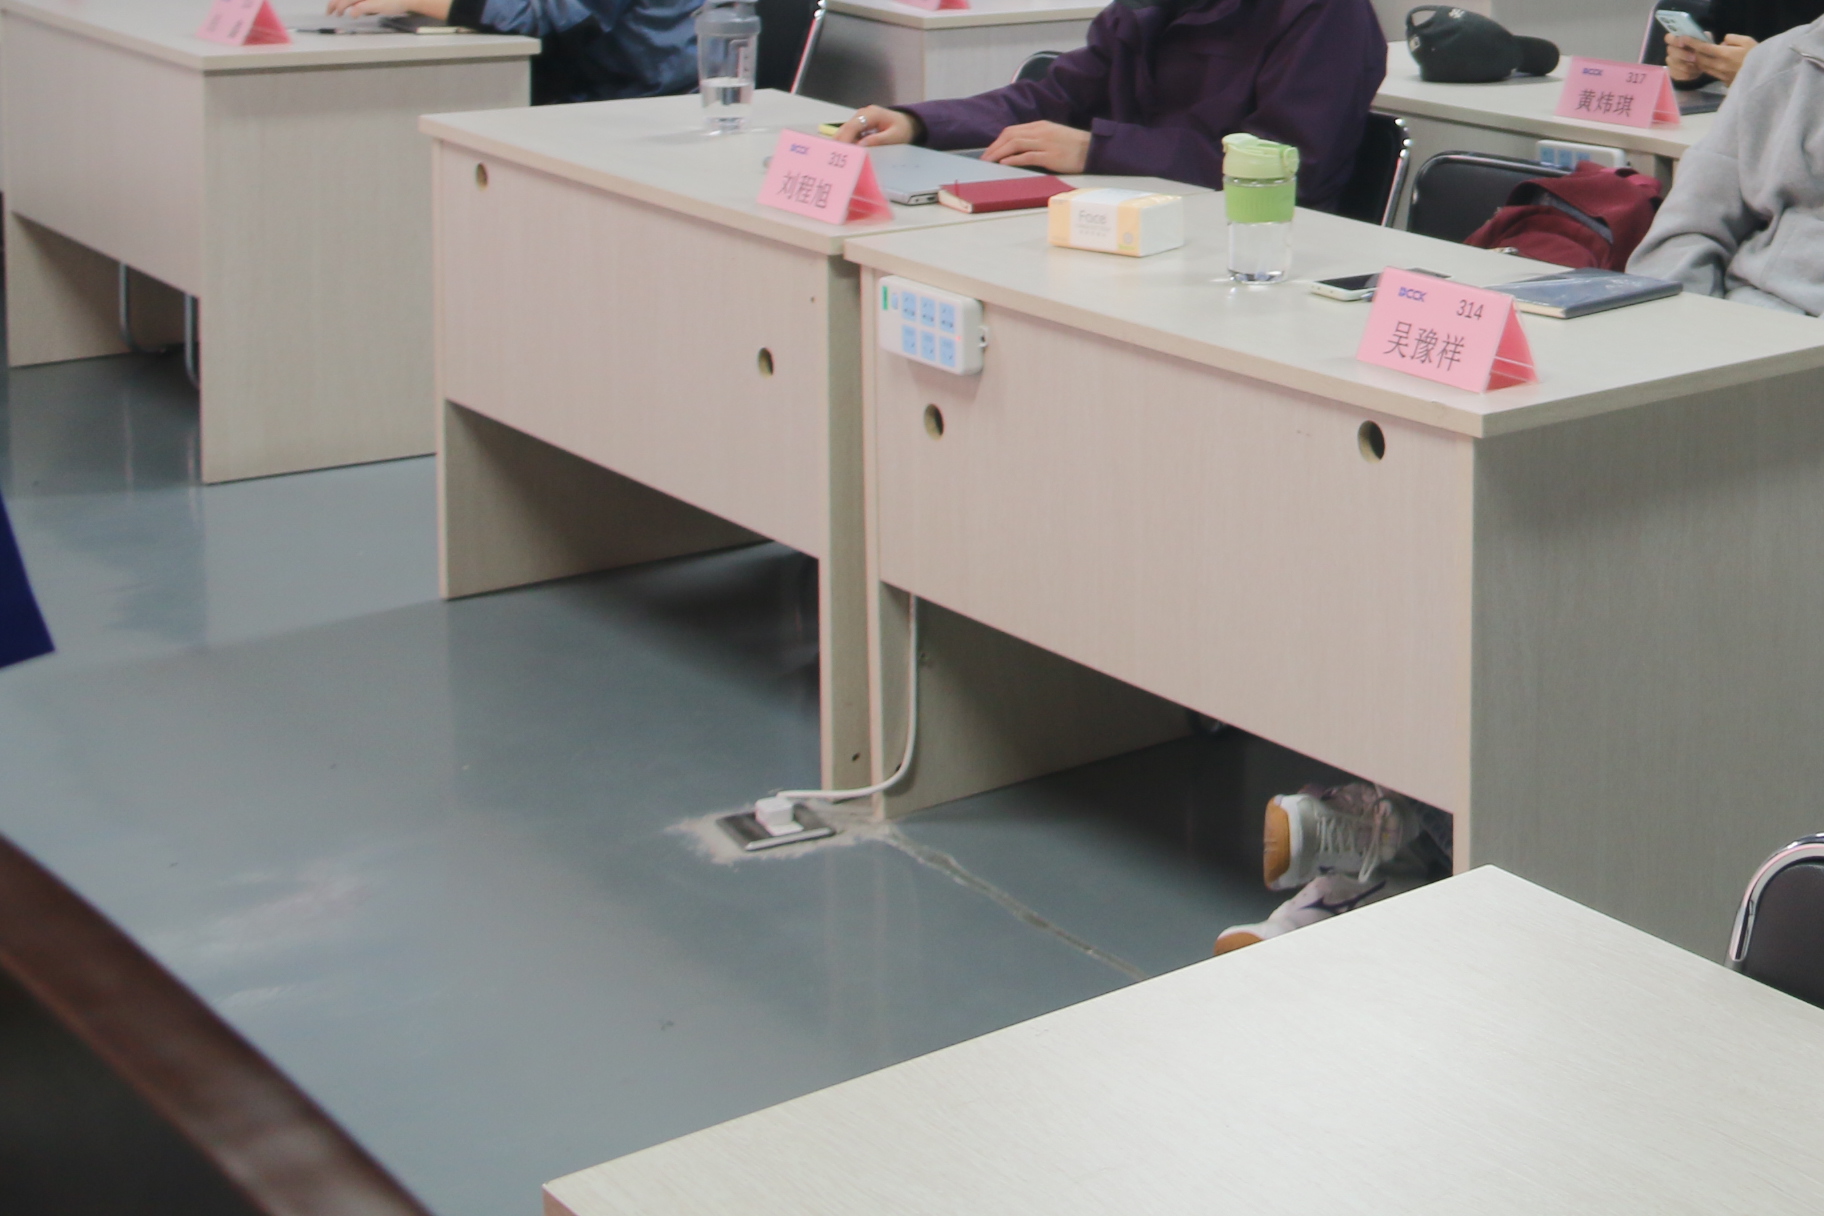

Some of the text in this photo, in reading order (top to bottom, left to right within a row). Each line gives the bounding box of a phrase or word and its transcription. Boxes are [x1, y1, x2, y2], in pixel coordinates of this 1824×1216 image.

[1626, 72, 1647, 84] 317
[1576, 89, 1634, 117] 黄炜琪
[828, 151, 848, 168] 315
[777, 170, 832, 209] 刘程旭
[1398, 287, 1427, 302] DCCK
[1456, 299, 1485, 320] 314
[1383, 321, 1465, 371] 吴豫祥
